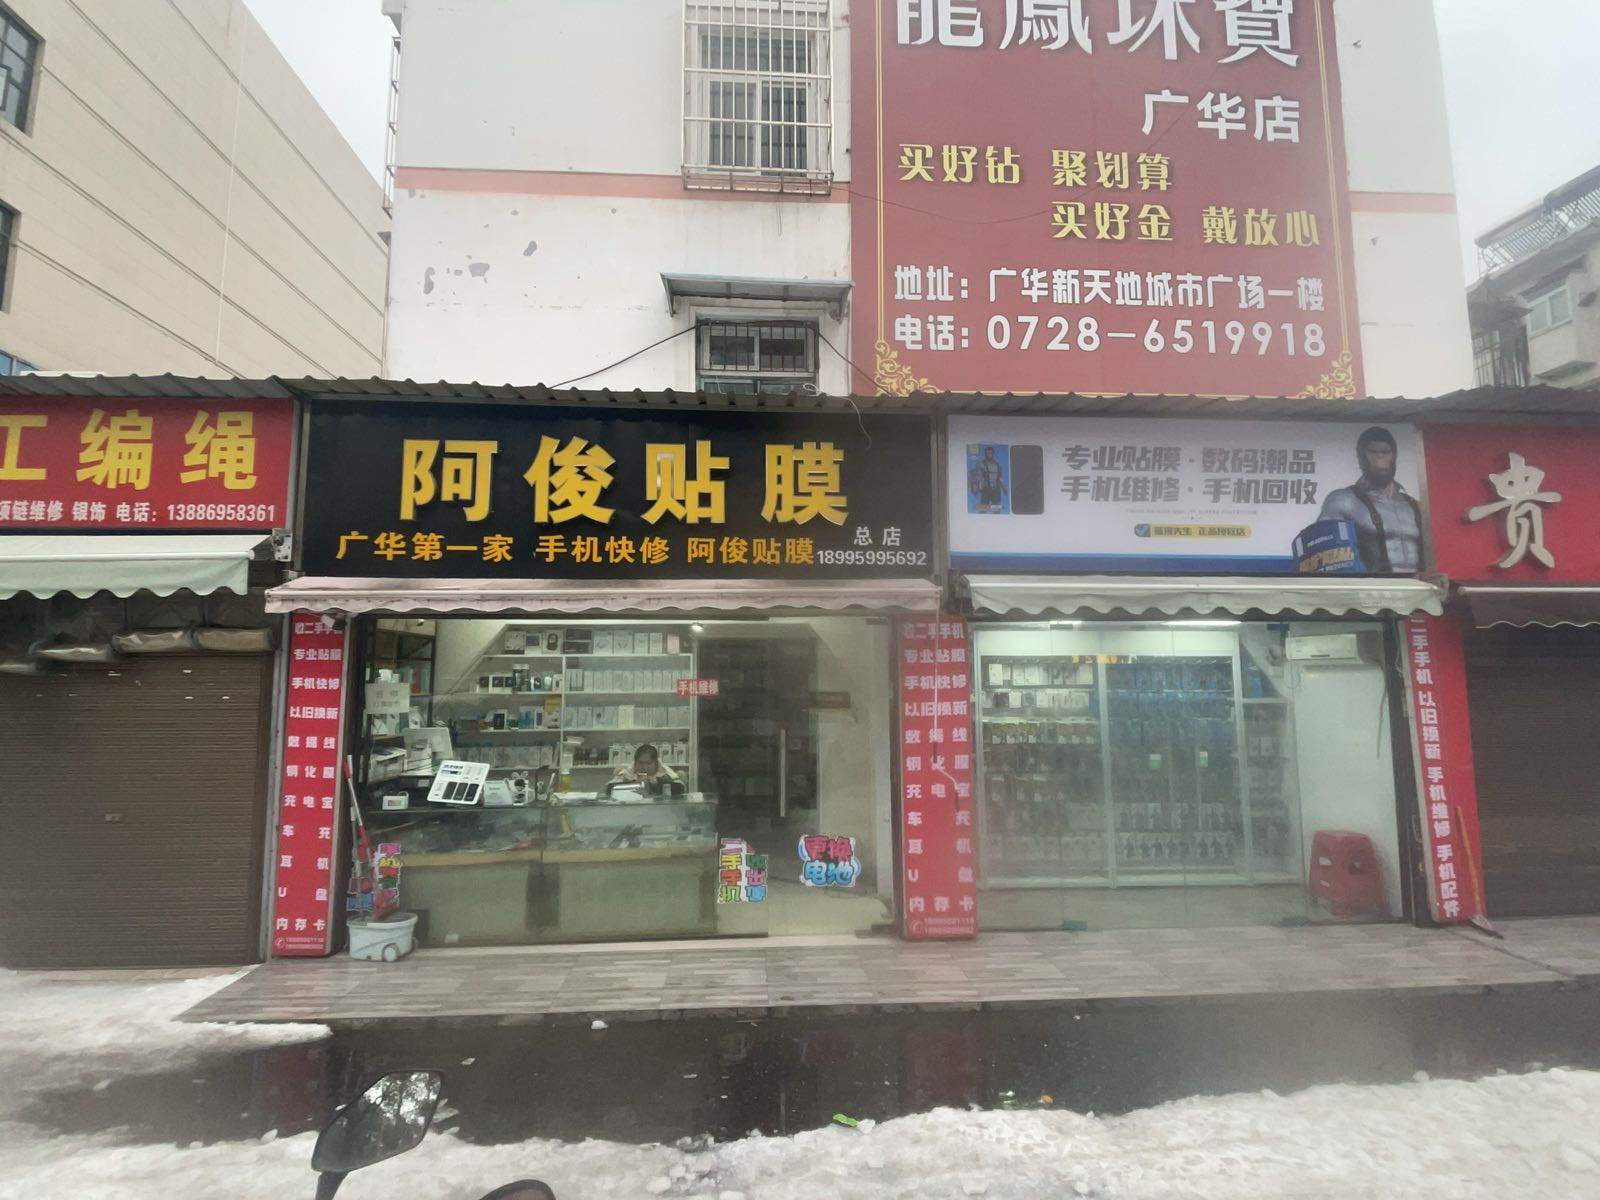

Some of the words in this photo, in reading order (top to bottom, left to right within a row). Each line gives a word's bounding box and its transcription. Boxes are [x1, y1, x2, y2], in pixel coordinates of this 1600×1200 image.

[1142, 89, 1300, 143] 广华店
[898, 144, 1021, 184] 买好钻
[1052, 149, 1172, 191] 聚划算
[1052, 201, 1173, 241] 买好金
[1202, 206, 1321, 247] 戴放心
[0, 409, 257, 490] 工编绳
[400, 435, 848, 526] 阿俊贴膜
[72, 501, 107, 522] 银饰
[1461, 451, 1562, 569] 贵
[337, 531, 512, 562] 广华第一家
[536, 533, 670, 564] 手机快修
[688, 535, 816, 565] 阿俊贴膜
[853, 526, 901, 548] 总店
[817, 549, 927, 567] 18995995692
[292, 677, 340, 689] 手机快修
[290, 706, 338, 719] 以旧换新
[284, 795, 333, 808] 充电宝
[803, 859, 855, 885] 电池
[276, 917, 326, 931] 内存卡
